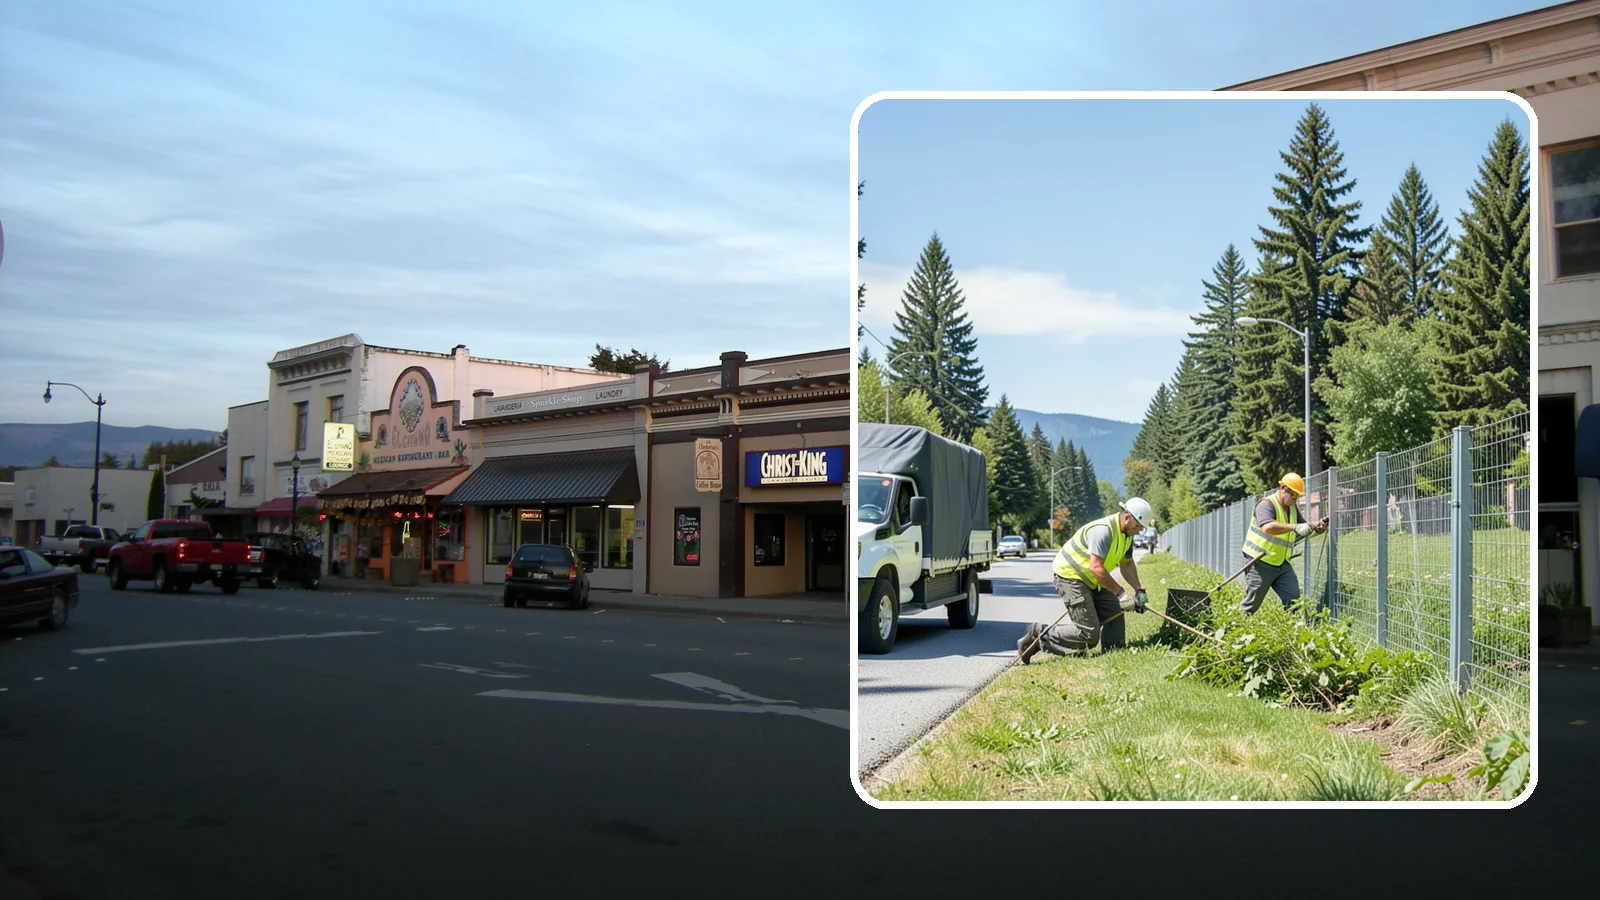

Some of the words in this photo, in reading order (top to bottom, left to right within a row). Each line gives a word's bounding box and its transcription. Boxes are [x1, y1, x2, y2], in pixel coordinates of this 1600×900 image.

[595, 389, 624, 400] LAUNDRY
[493, 402, 523, 413] LAVANDERIA
[530, 398, 562, 410] Sparkle
[561, 394, 583, 405] Shop
[374, 455, 396, 464] MEXICAN
[397, 451, 433, 462] RESTAURANT
[437, 450, 450, 459] BAR
[799, 450, 827, 477] KING
